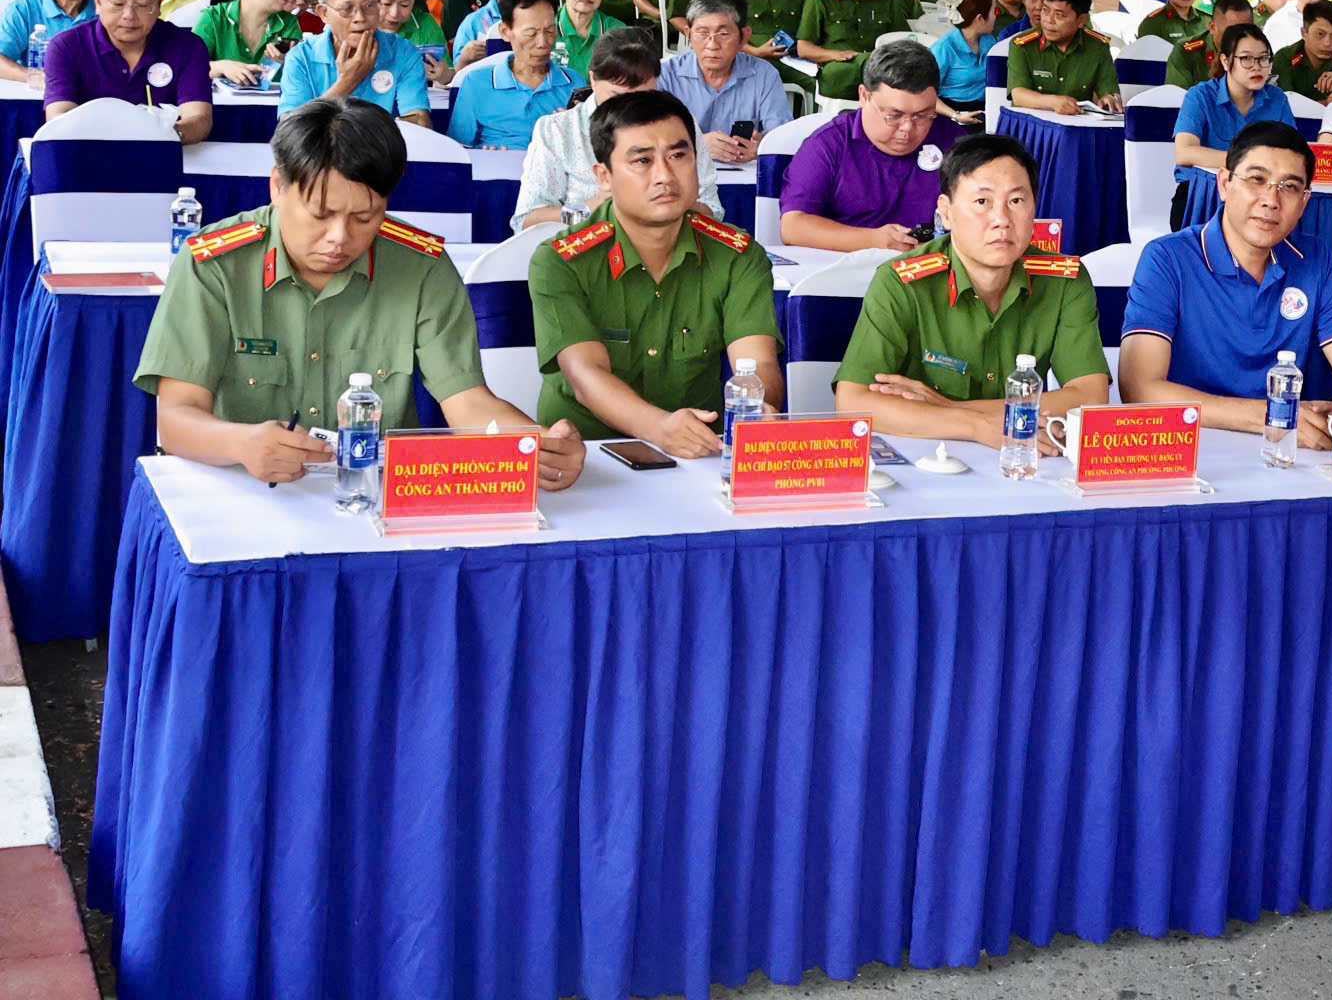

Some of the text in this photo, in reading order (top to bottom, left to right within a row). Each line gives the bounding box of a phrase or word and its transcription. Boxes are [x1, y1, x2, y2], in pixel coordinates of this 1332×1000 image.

[1084, 432, 1194, 450] LÊ QUANG TRUNG
[394, 463, 416, 478] ĐẠI
[420, 461, 449, 477] DIỆN
[452, 459, 495, 475] PHÒNG
[498, 462, 514, 473] PH
[395, 478, 526, 497] CÔNG AN THÀNH PHỐ
